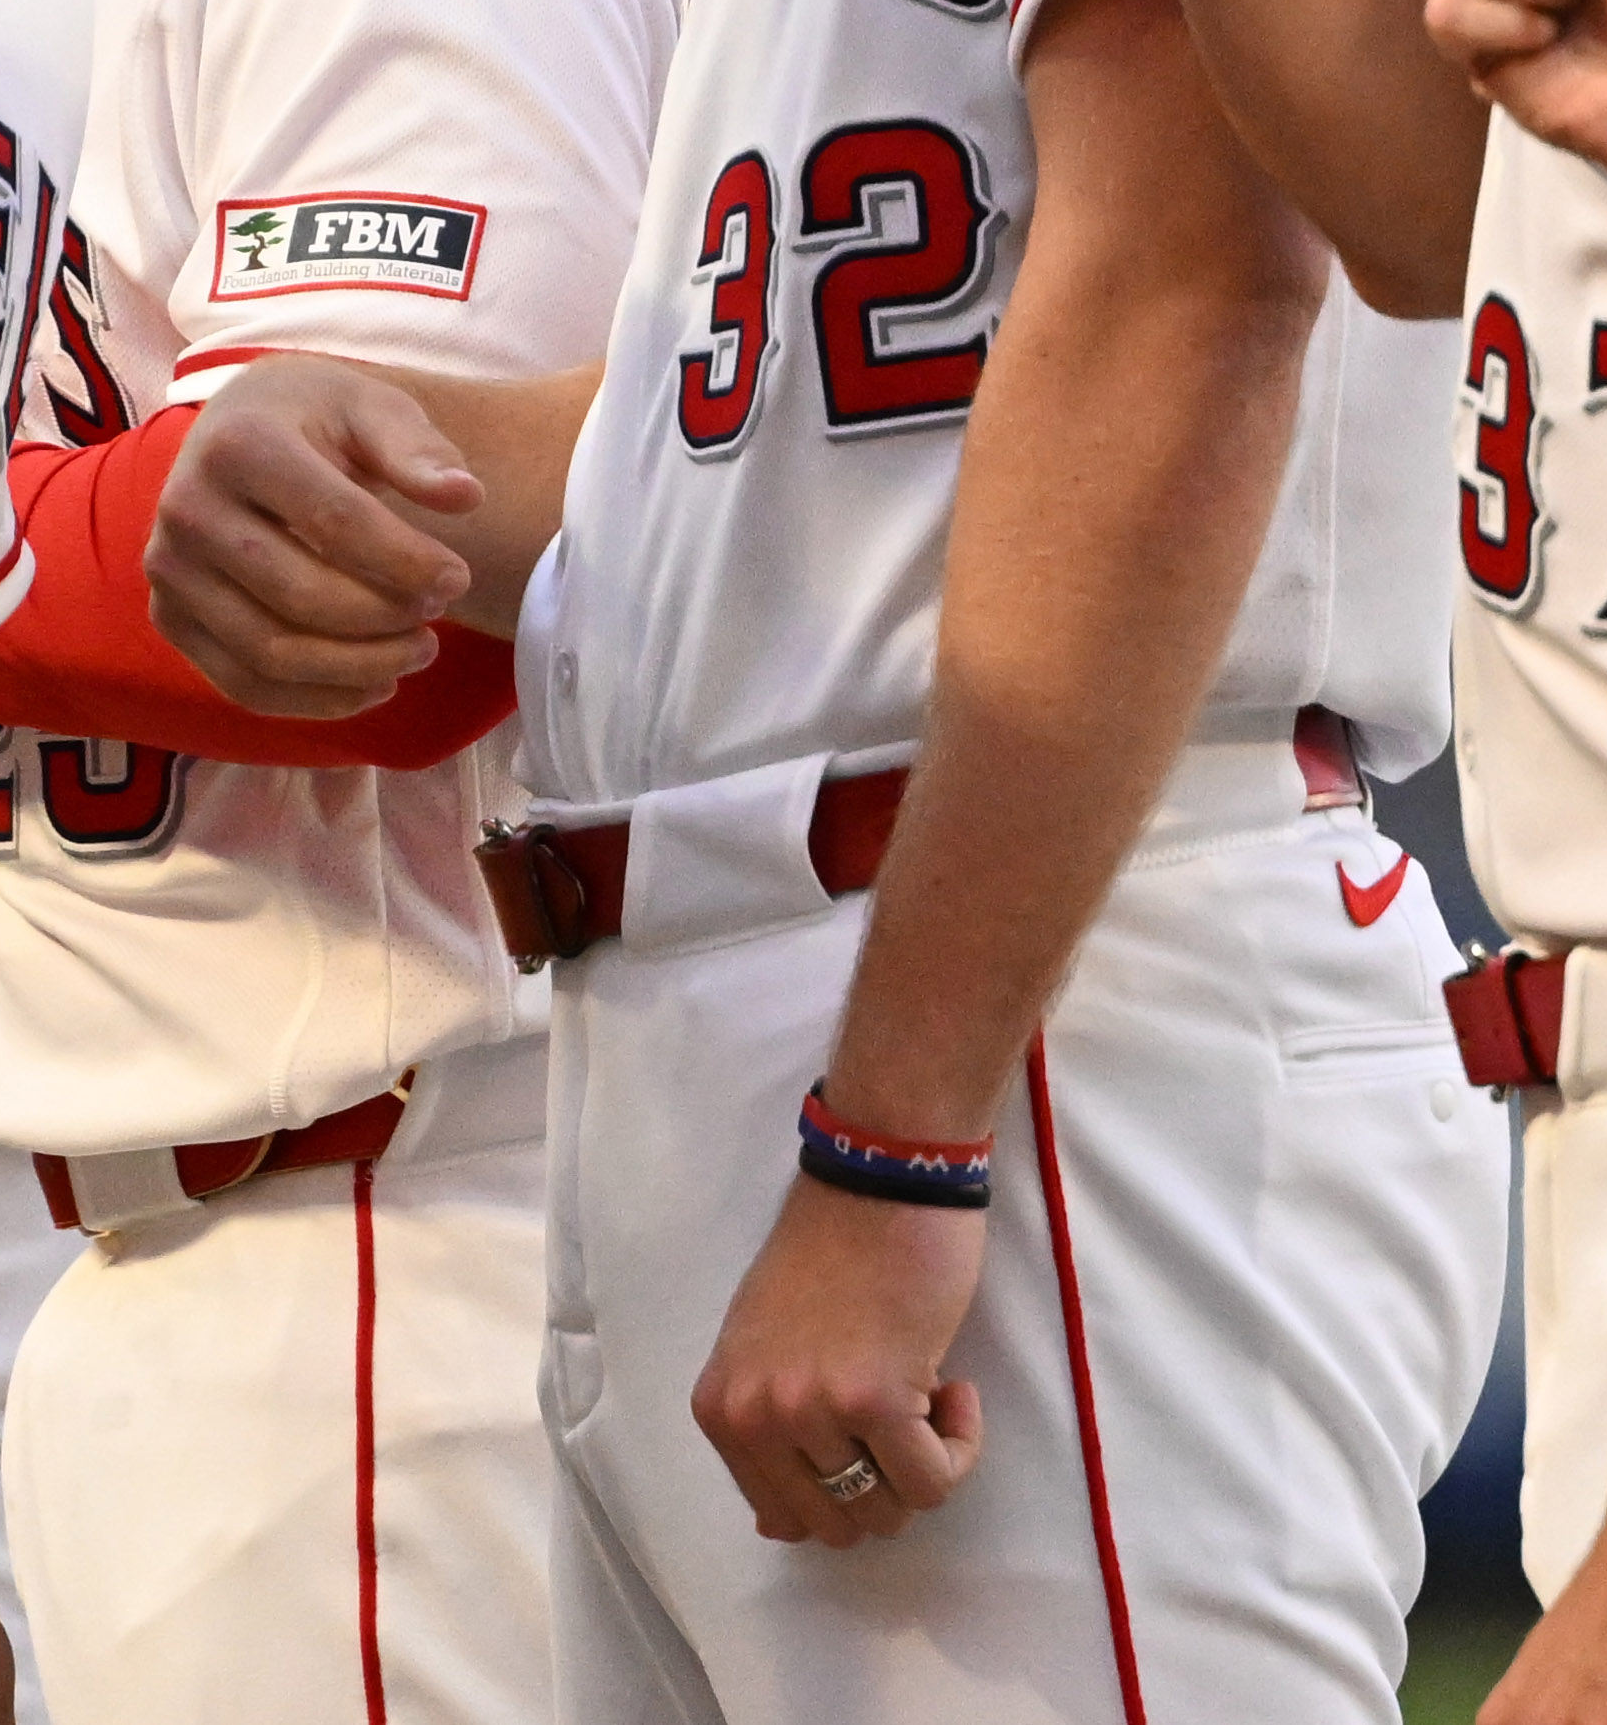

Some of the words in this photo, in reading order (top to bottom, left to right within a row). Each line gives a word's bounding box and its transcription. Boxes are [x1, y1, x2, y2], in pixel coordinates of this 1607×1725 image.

[307, 210, 446, 259] FBM
[221, 267, 299, 290] Foundation
[304, 262, 370, 279] Building
[377, 262, 461, 287] Materials
[676, 116, 1010, 463] 32
